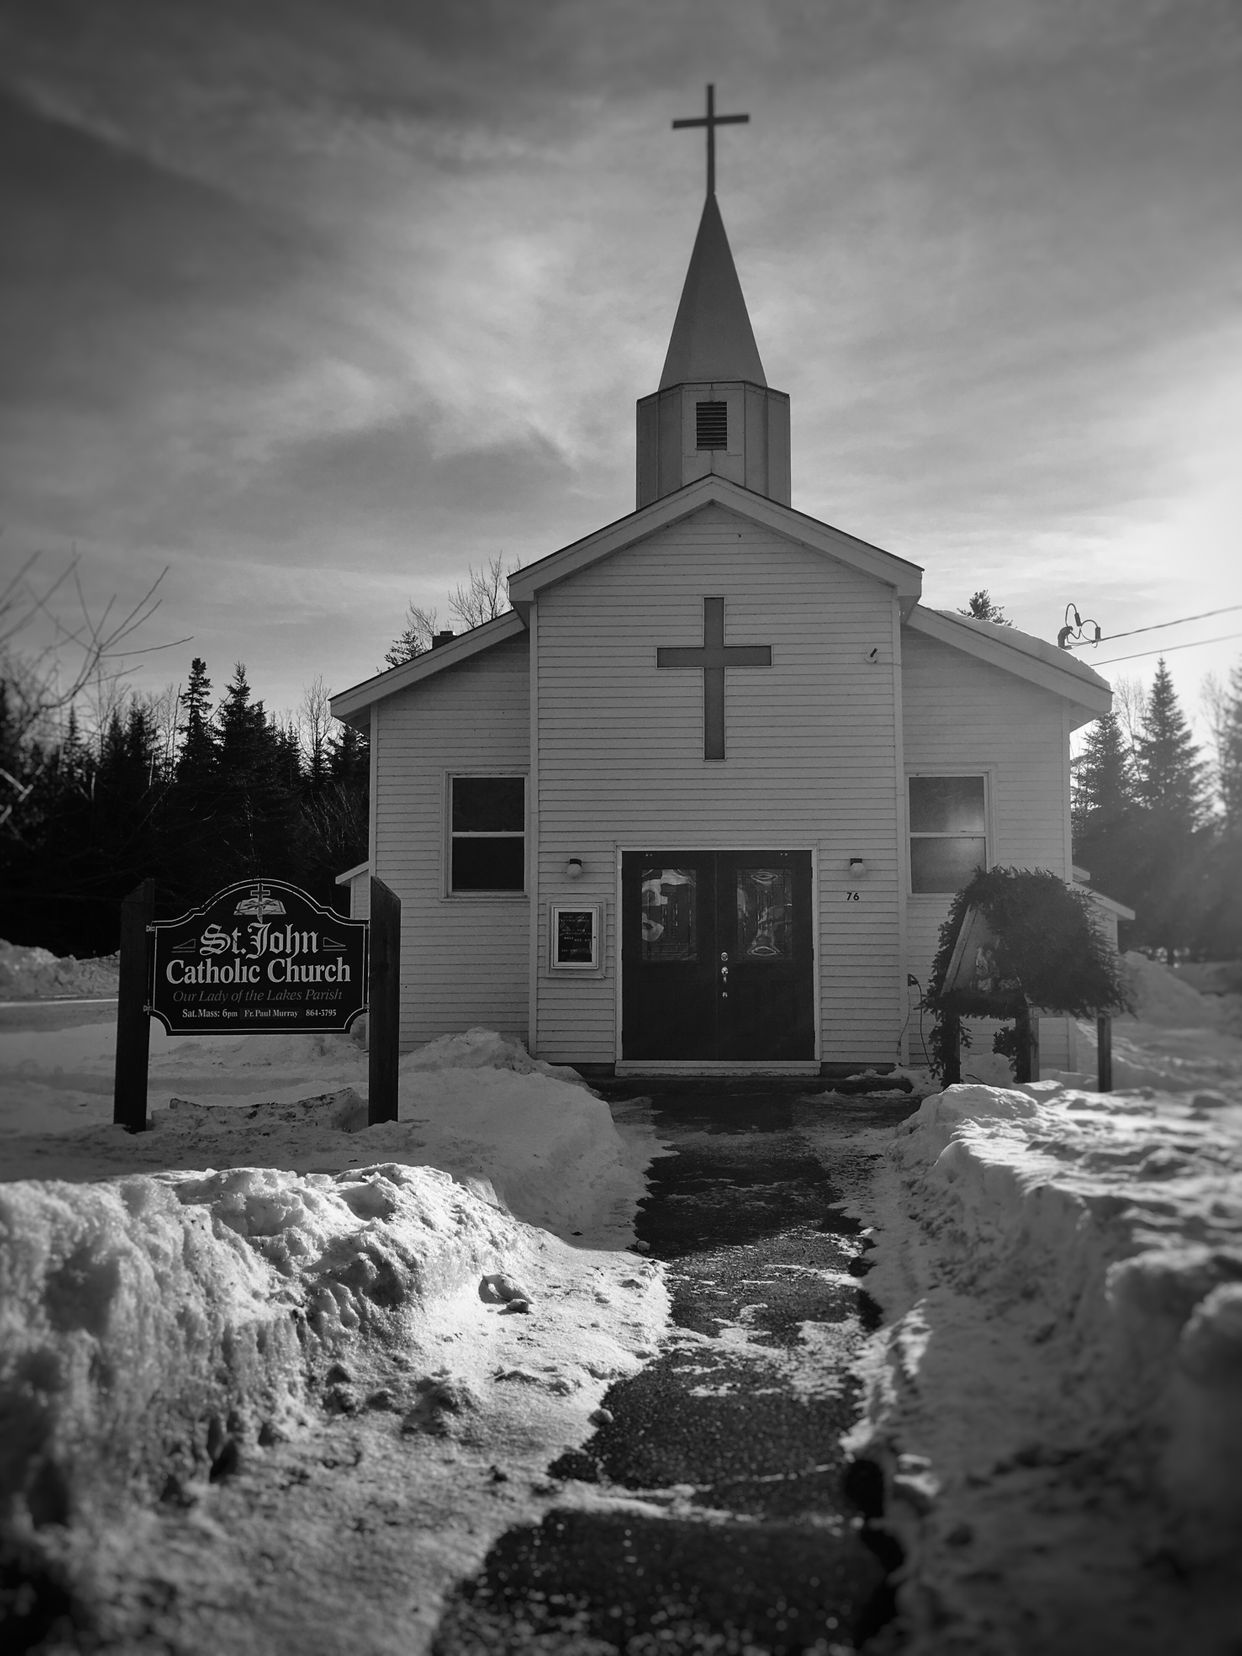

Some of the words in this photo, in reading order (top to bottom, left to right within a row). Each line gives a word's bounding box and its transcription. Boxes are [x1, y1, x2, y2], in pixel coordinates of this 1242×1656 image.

[847, 892, 860, 901] 76
[200, 924, 246, 956] St.
[246, 922, 319, 959] John
[166, 958, 260, 985] Catholic
[267, 957, 351, 983] Church
[173, 990, 197, 1001] Our
[199, 990, 229, 1004] Lady
[231, 990, 244, 1003] of
[246, 990, 264, 1001] the
[267, 989, 301, 1001] Lakes
[305, 988, 342, 1000] Parish
[182, 1008, 197, 1018] Sat.
[198, 1008, 220, 1018] Mass:
[222, 1008, 238, 1019] 6pm
[255, 1009, 271, 1017] Paul
[273, 1009, 298, 1018] Murray
[305, 1008, 337, 1017] 864-3795
